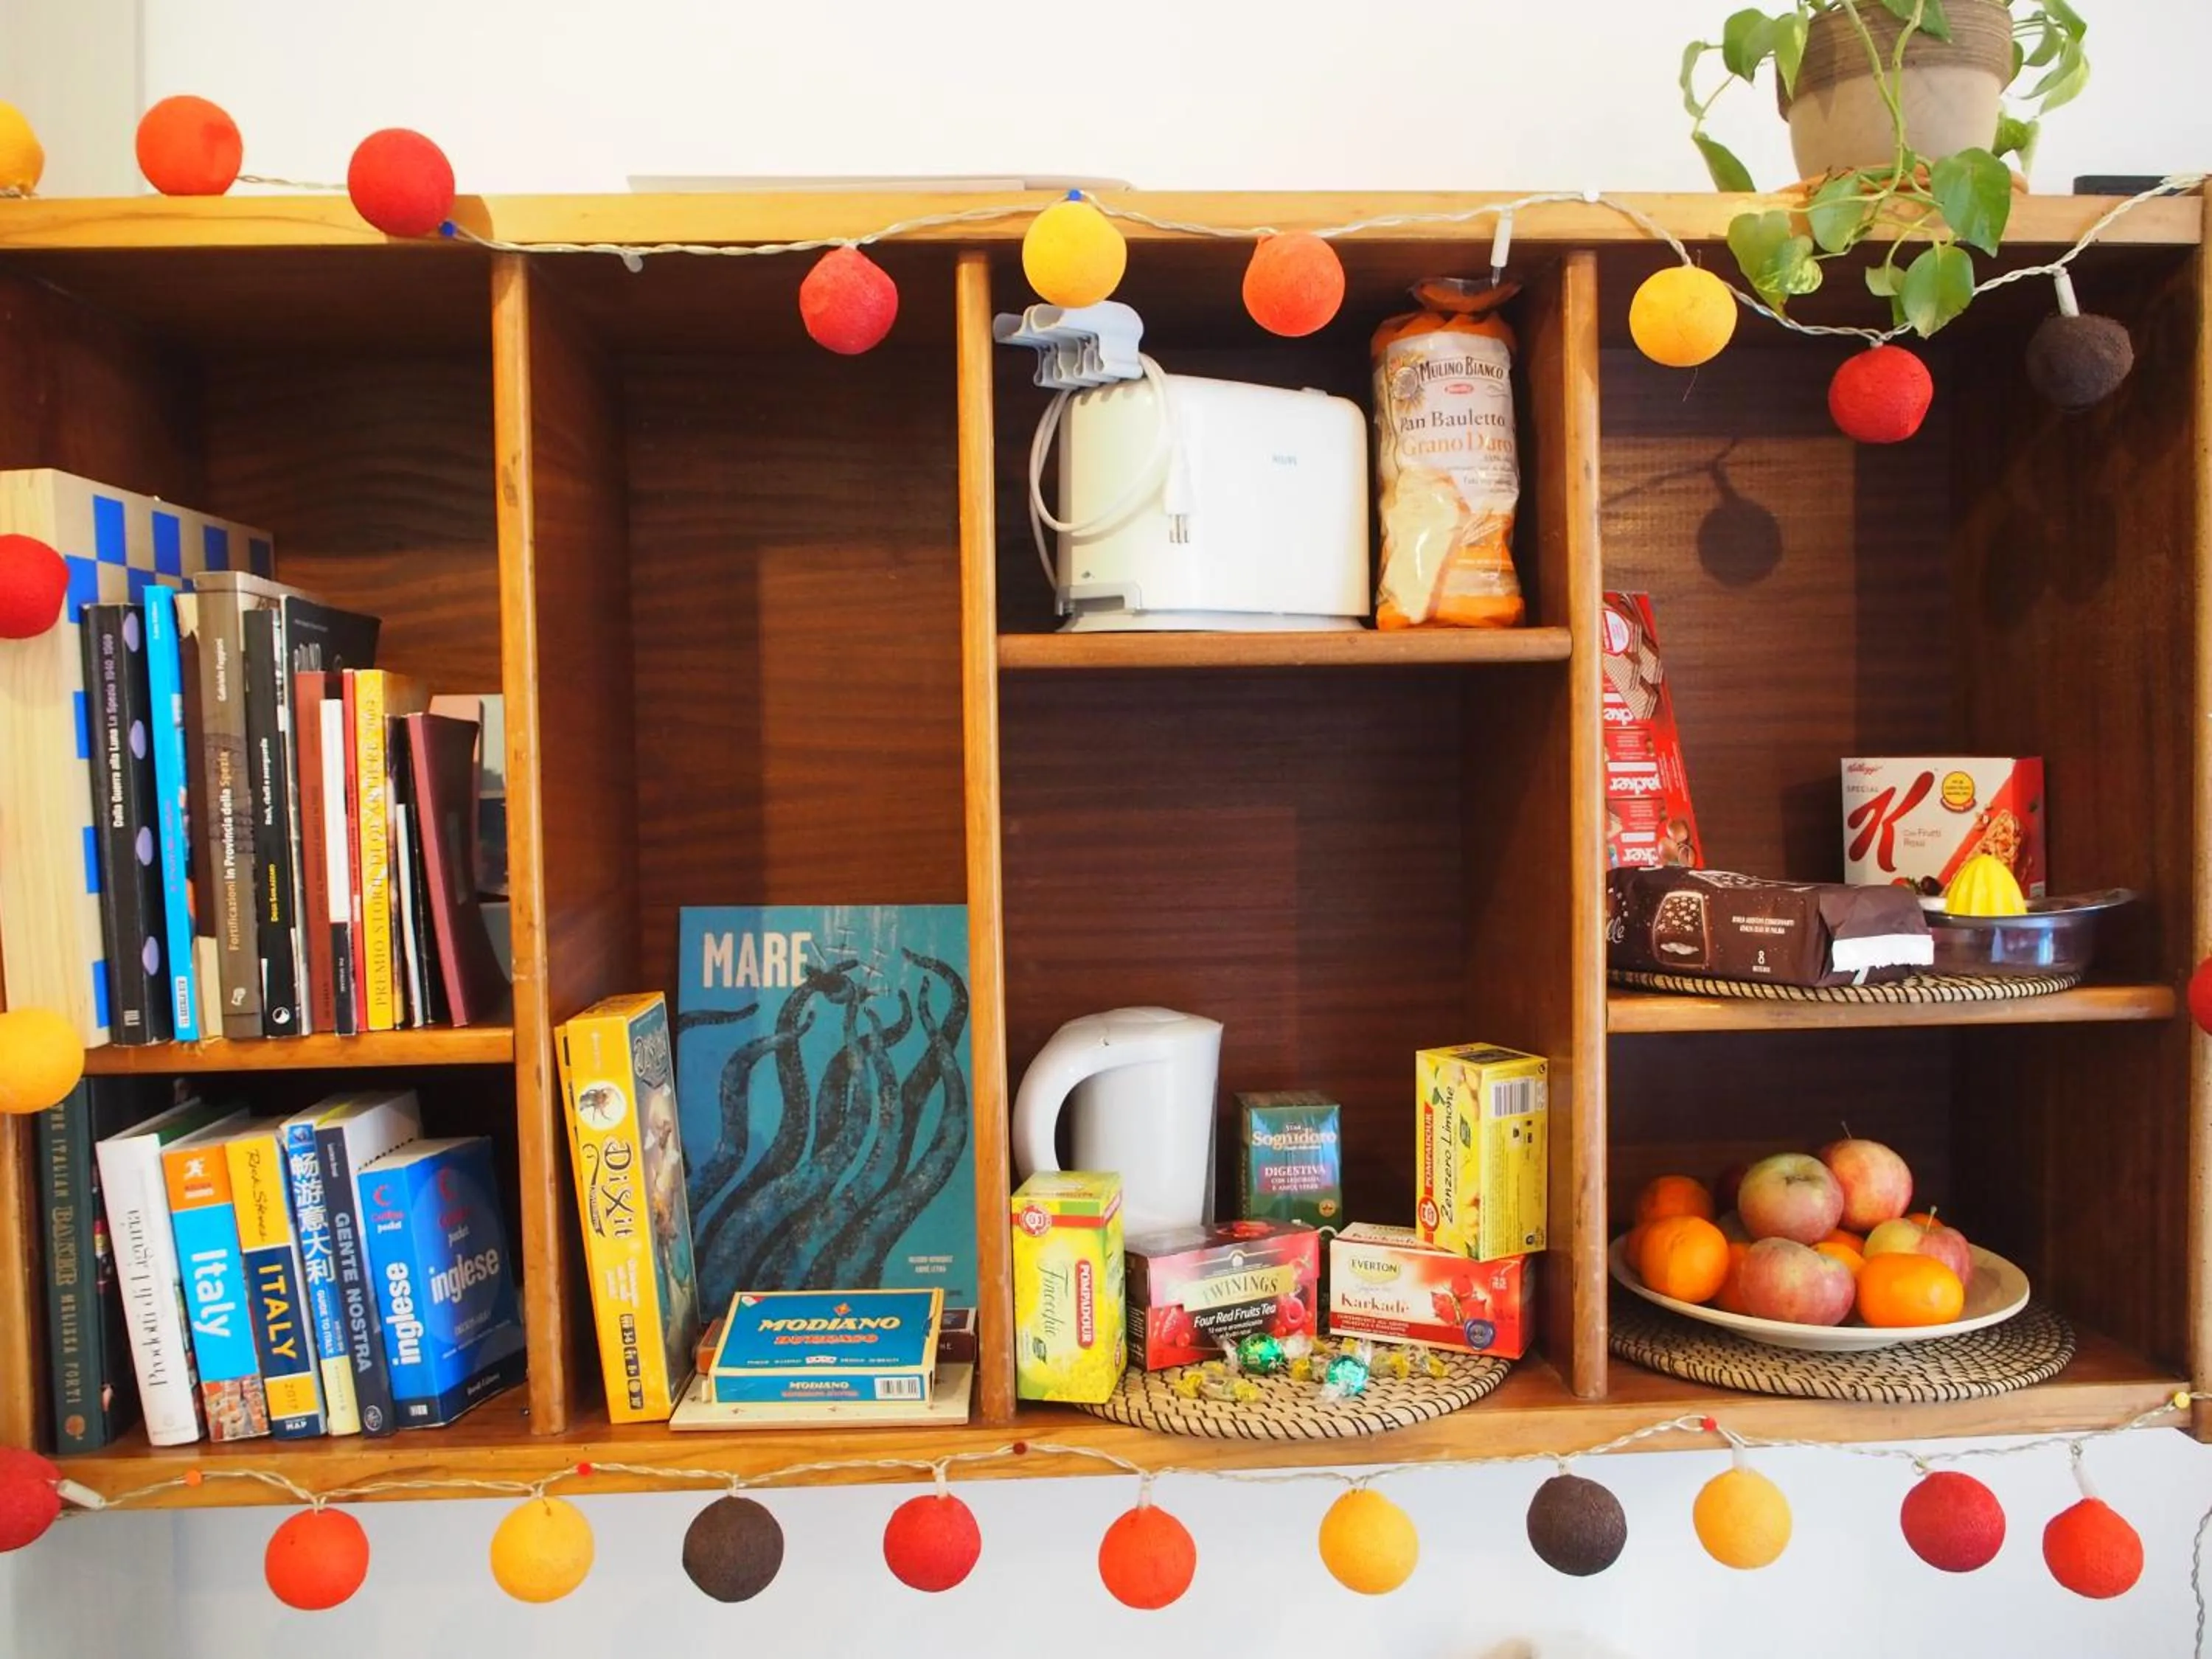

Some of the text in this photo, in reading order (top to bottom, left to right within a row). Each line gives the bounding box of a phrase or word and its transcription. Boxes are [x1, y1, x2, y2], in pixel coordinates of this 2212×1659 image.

[1419, 356, 1504, 381] MULINO BIANCO
[1400, 408, 1506, 432] Pan Bauletto
[1401, 435, 1464, 456] Grano
[365, 742, 383, 843] QUARTIERE
[1846, 785, 1879, 793] SPECIAL
[218, 751, 240, 950] Fortificazioni in Provincia della Spezia
[1847, 771, 1935, 872] K
[369, 846, 383, 866] DI
[370, 877, 385, 934] STORIE
[373, 939, 389, 1006] PREMIO
[703, 931, 813, 989] MARE
[1757, 950, 1765, 965] 8
[51, 1138, 69, 1198] ITALIAN
[1265, 1164, 1326, 1177] DIGESTIVA
[1425, 1111, 1434, 1189] POMPADOUR
[1439, 1085, 1455, 1224] Zenzero Limone
[289, 1152, 335, 1285] 畅游意大利
[190, 1248, 236, 1338] Italy
[333, 1212, 372, 1374] GENTE NOSTRA
[428, 1247, 500, 1305] inglese
[1202, 1274, 1279, 1306] TWININGS
[1351, 1258, 1397, 1273] EVERTON
[59, 1293, 77, 1353] MELISSA
[119, 1209, 167, 1386] Prodotti di Liguria
[258, 1264, 298, 1359] ITALY
[386, 1261, 424, 1367] inglese
[757, 1316, 901, 1332] MODIANO
[1078, 1264, 1092, 1342] POMPADOUR
[1194, 1303, 1276, 1328] Four Red Fruits Tea
[789, 1380, 850, 1390] MODIANO
